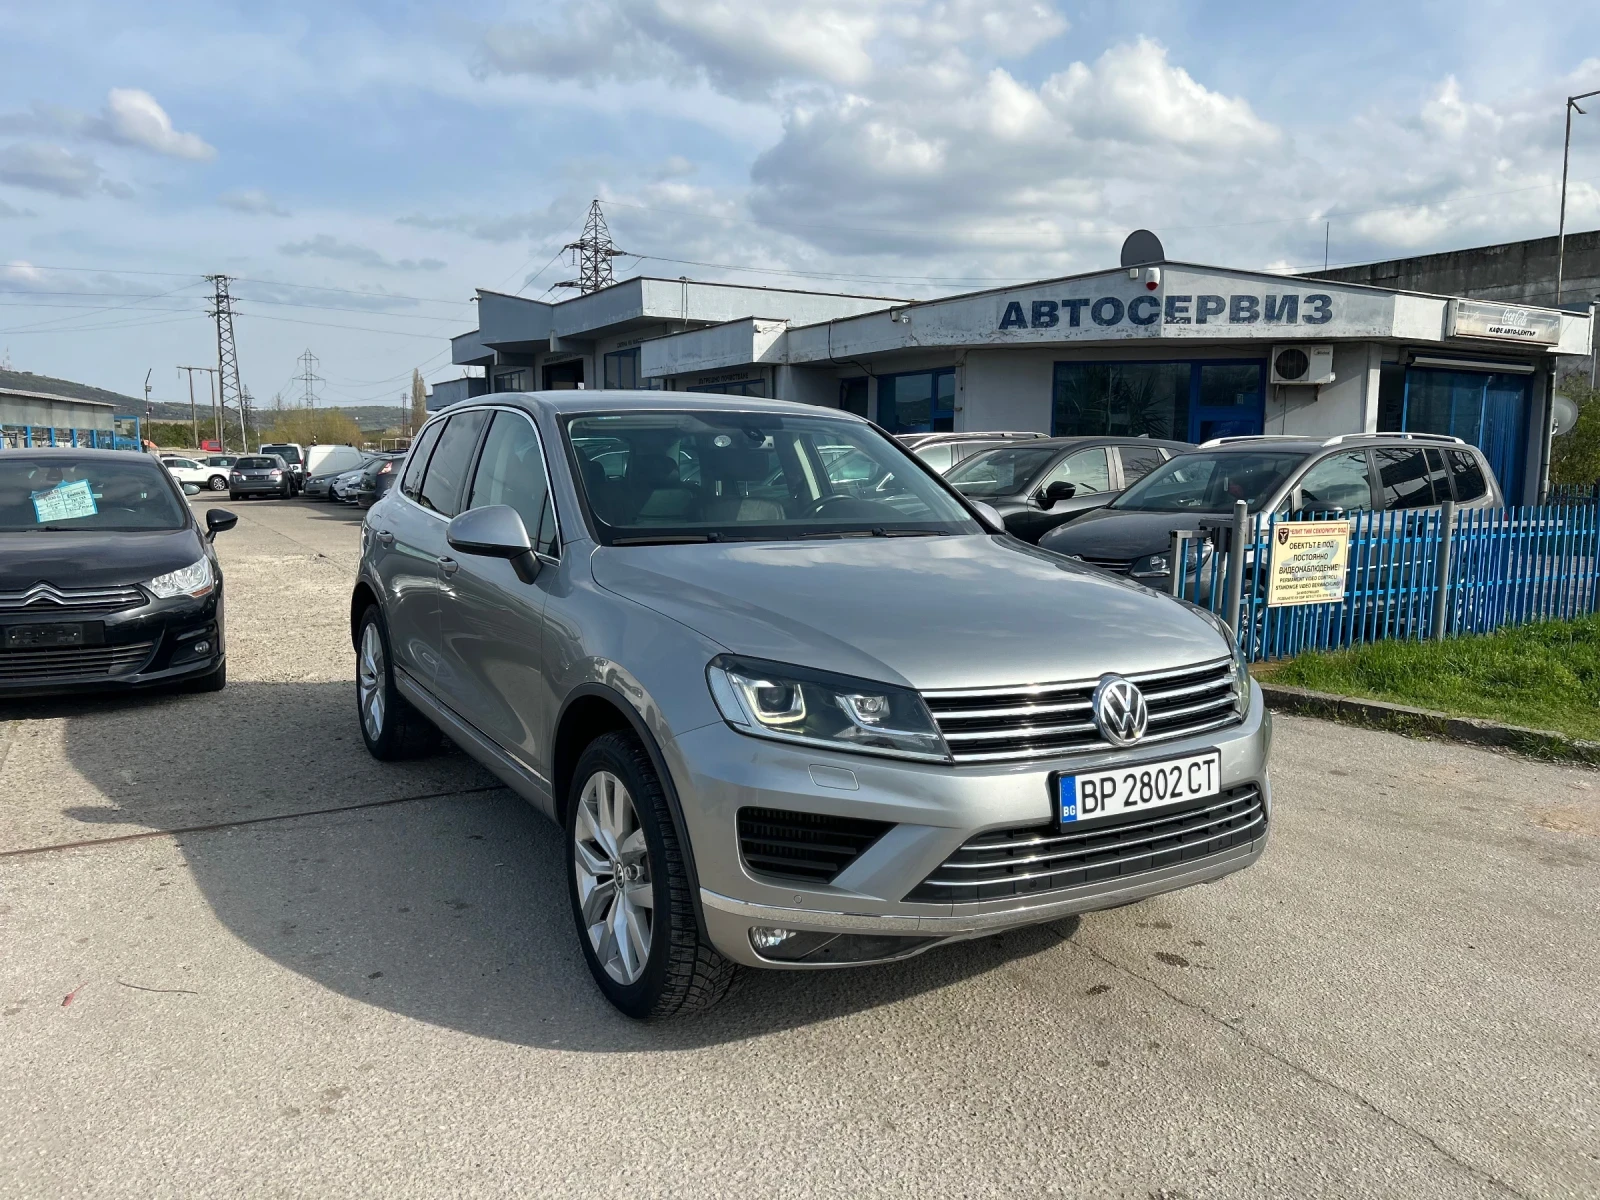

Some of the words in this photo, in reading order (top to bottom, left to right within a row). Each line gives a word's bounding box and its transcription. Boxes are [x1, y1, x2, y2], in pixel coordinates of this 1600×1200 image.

[998, 293, 1333, 330] АВТОСЕРВИЗ
[1293, 553, 1328, 561] ПОСТОЯННО
[1279, 564, 1340, 574] ВИДЕОНАБЛЮДЕНИЕ!
[1123, 765, 1183, 808] 2802
[1063, 805, 1076, 816] BG
